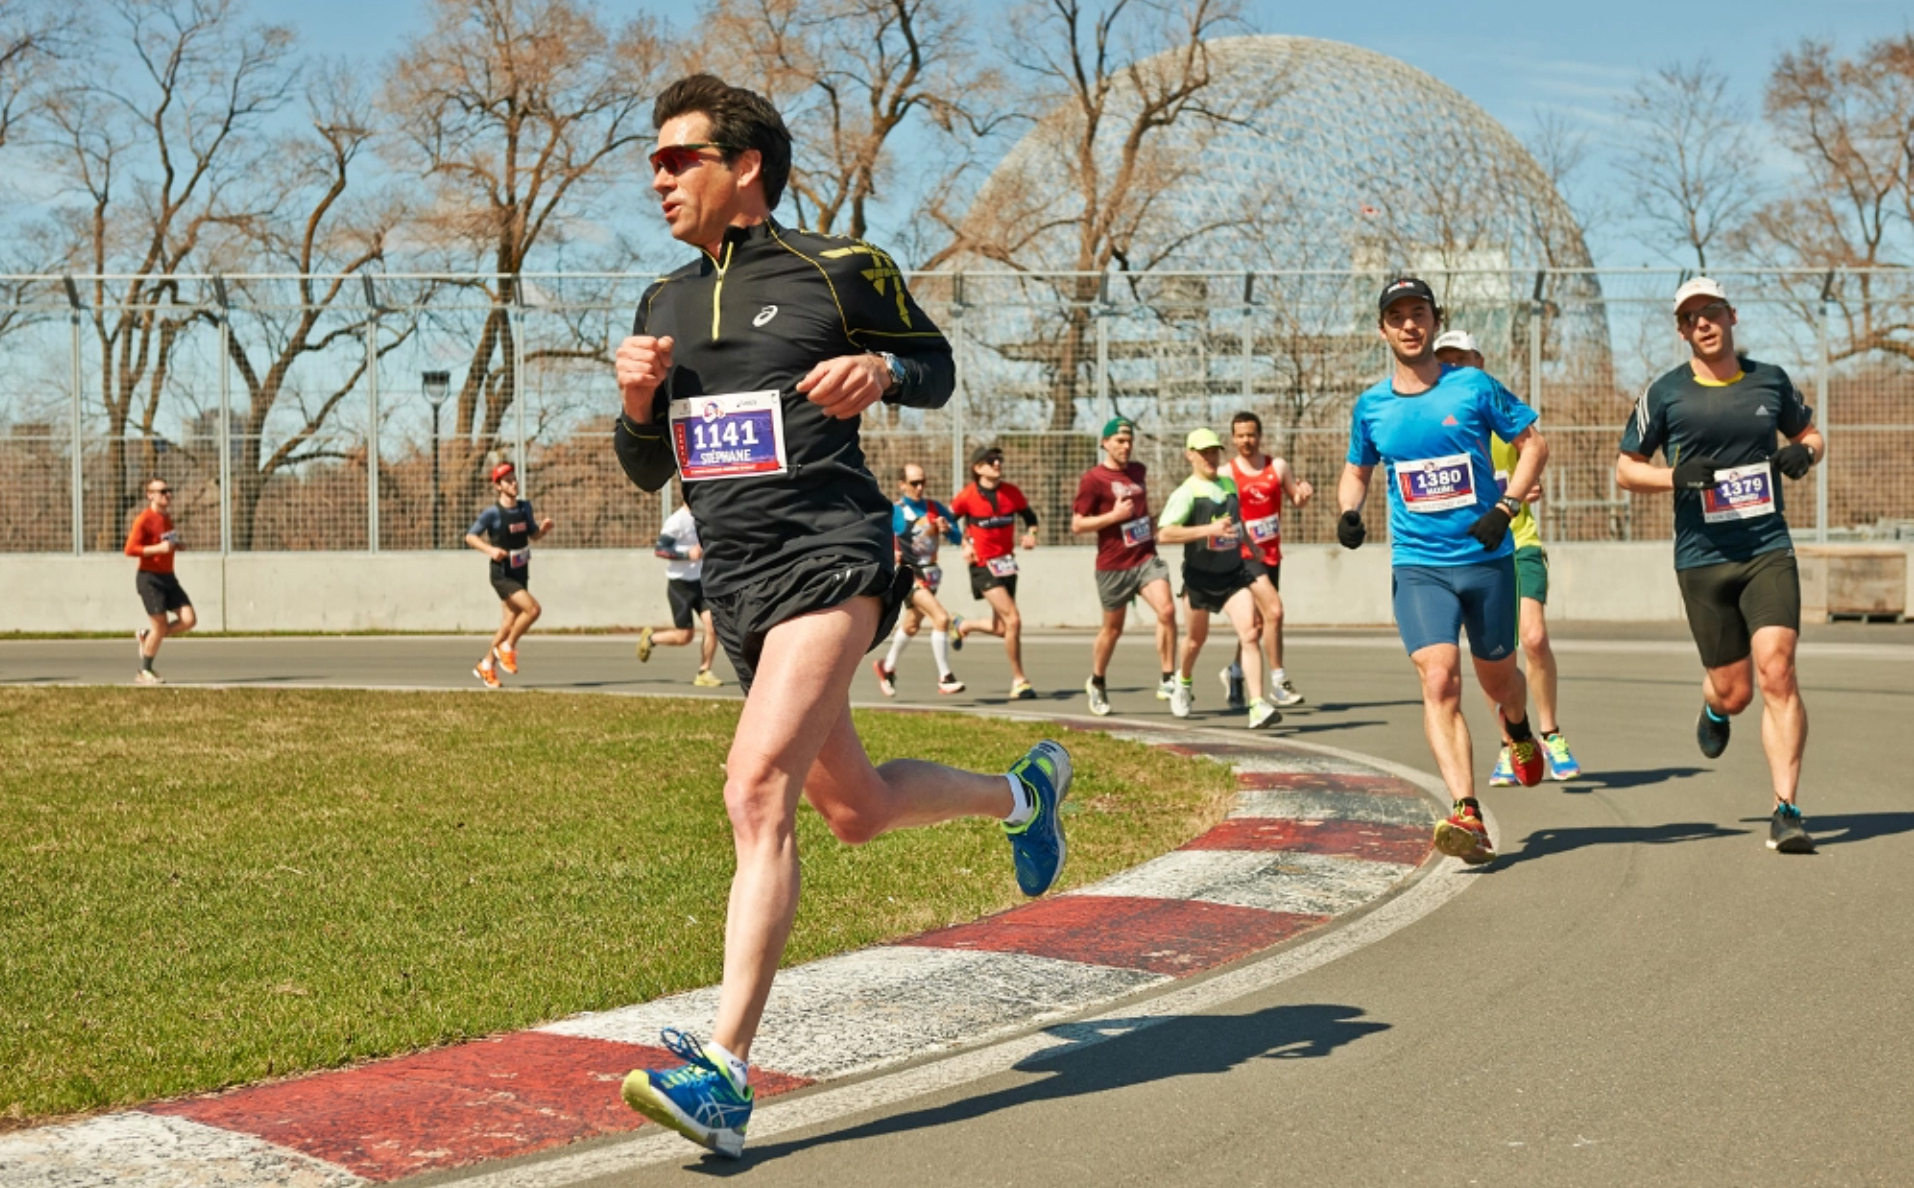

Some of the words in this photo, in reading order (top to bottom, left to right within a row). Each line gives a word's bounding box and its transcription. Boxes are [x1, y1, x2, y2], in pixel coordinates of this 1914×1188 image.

[694, 420, 759, 450] 1141
[1416, 469, 1462, 489] 1380
[1721, 477, 1763, 498] 1379
